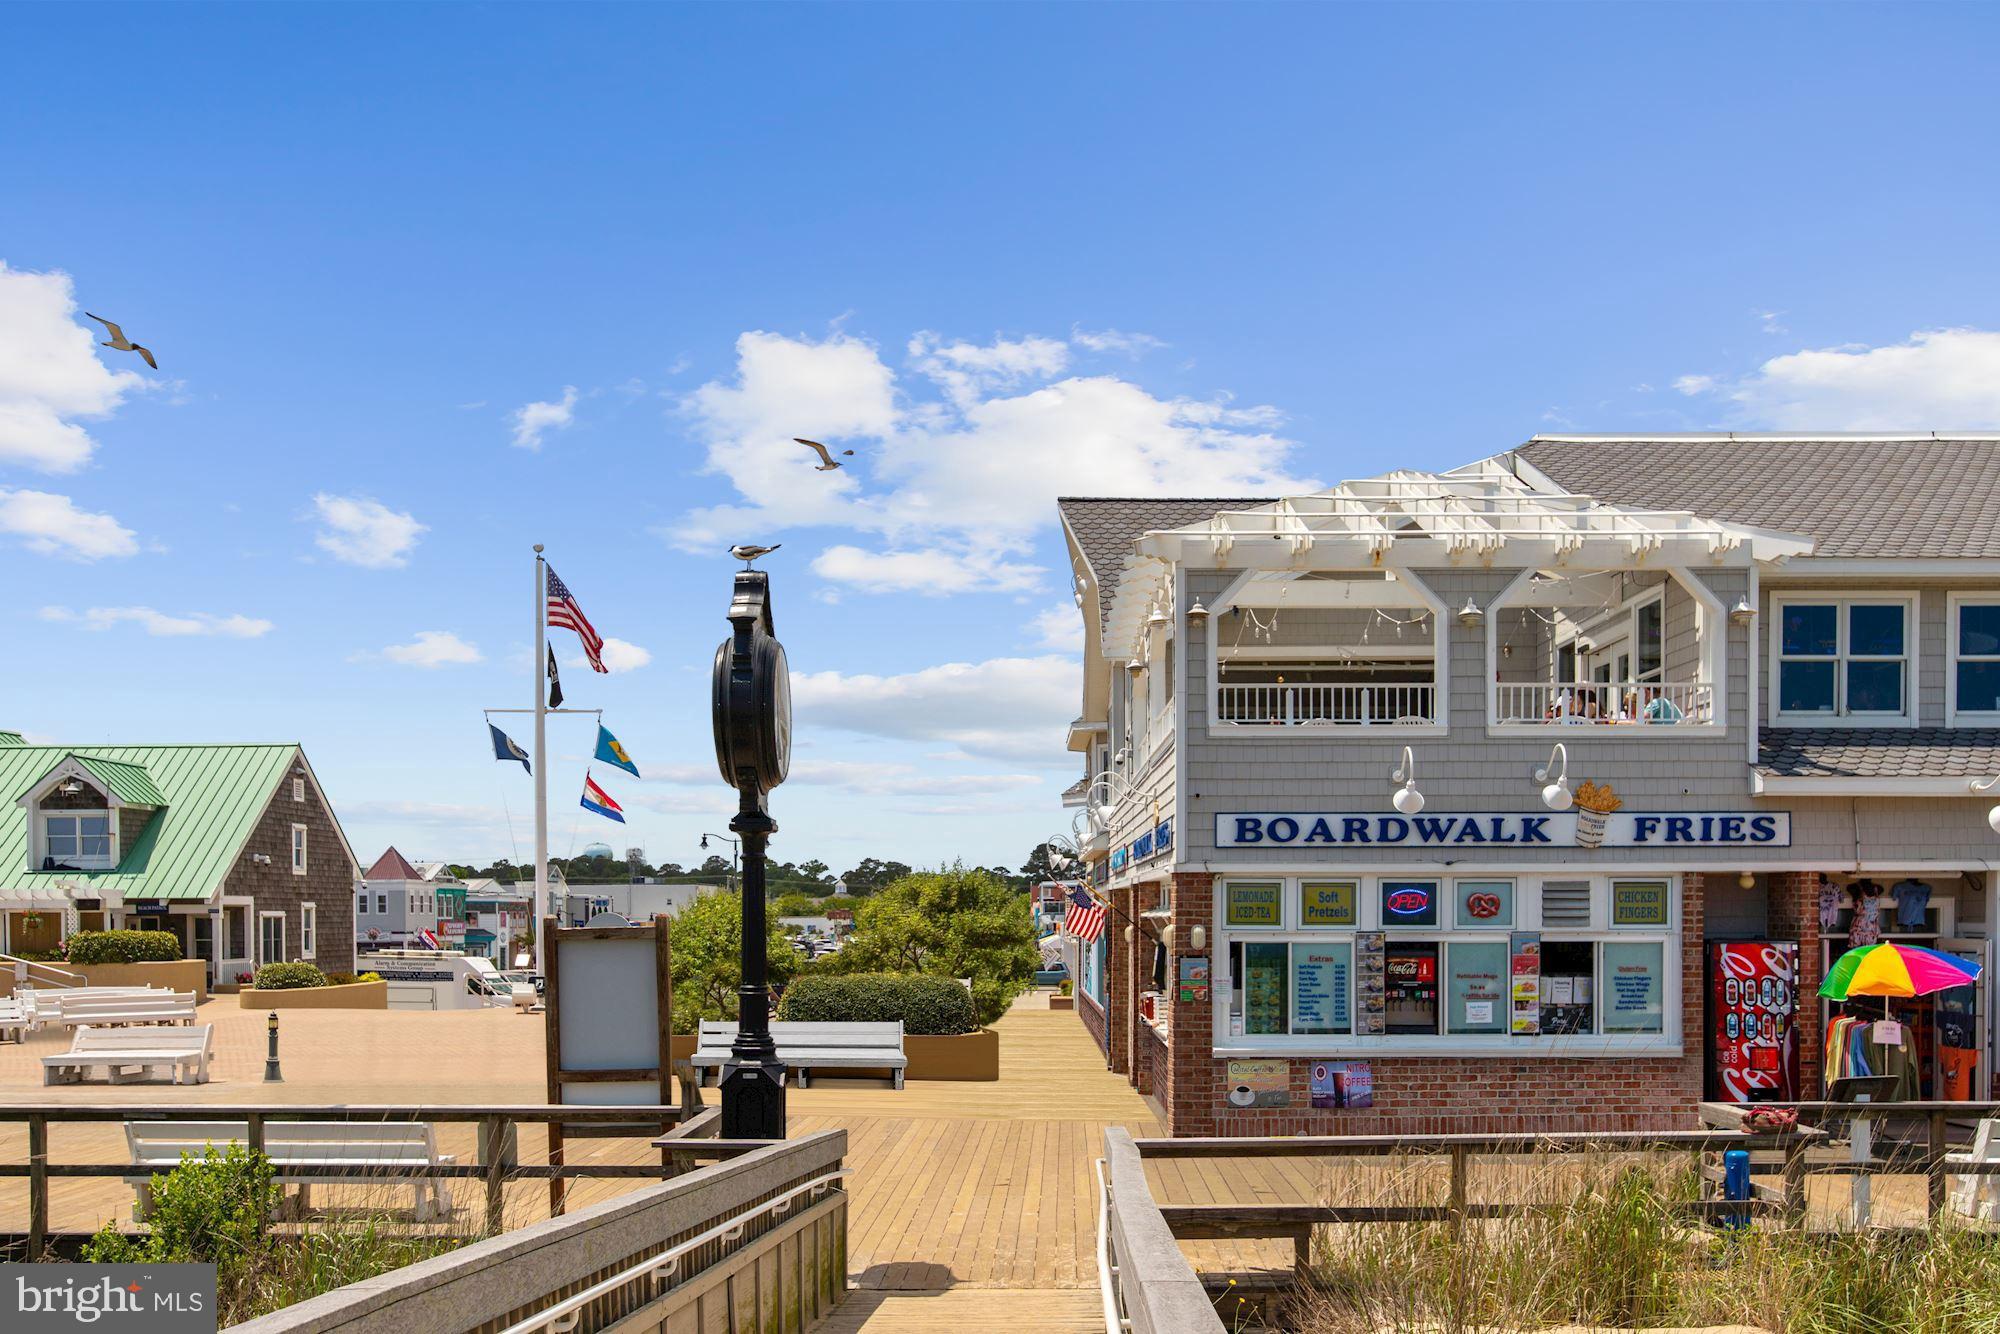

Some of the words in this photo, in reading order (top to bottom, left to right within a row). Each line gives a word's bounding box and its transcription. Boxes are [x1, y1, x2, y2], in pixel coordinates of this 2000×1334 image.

[1234, 817, 1552, 843] BOARDWALK
[1633, 816, 1776, 842] FRIES
[1232, 890, 1274, 903] LEMONADE
[1318, 891, 1339, 903] Soft
[1387, 893, 1429, 910] OPEN
[1618, 891, 1659, 903] CHICKEN
[1235, 906, 1271, 919] ICED-TEA
[1308, 906, 1349, 919] Pretzels
[1618, 906, 1659, 919] FINGERS
[1387, 963, 1418, 975] Coca-Cola
[1722, 1051, 1730, 1063] ice
[1730, 1045, 1738, 1064] cold
[1346, 1063, 1371, 1073] NITRO
